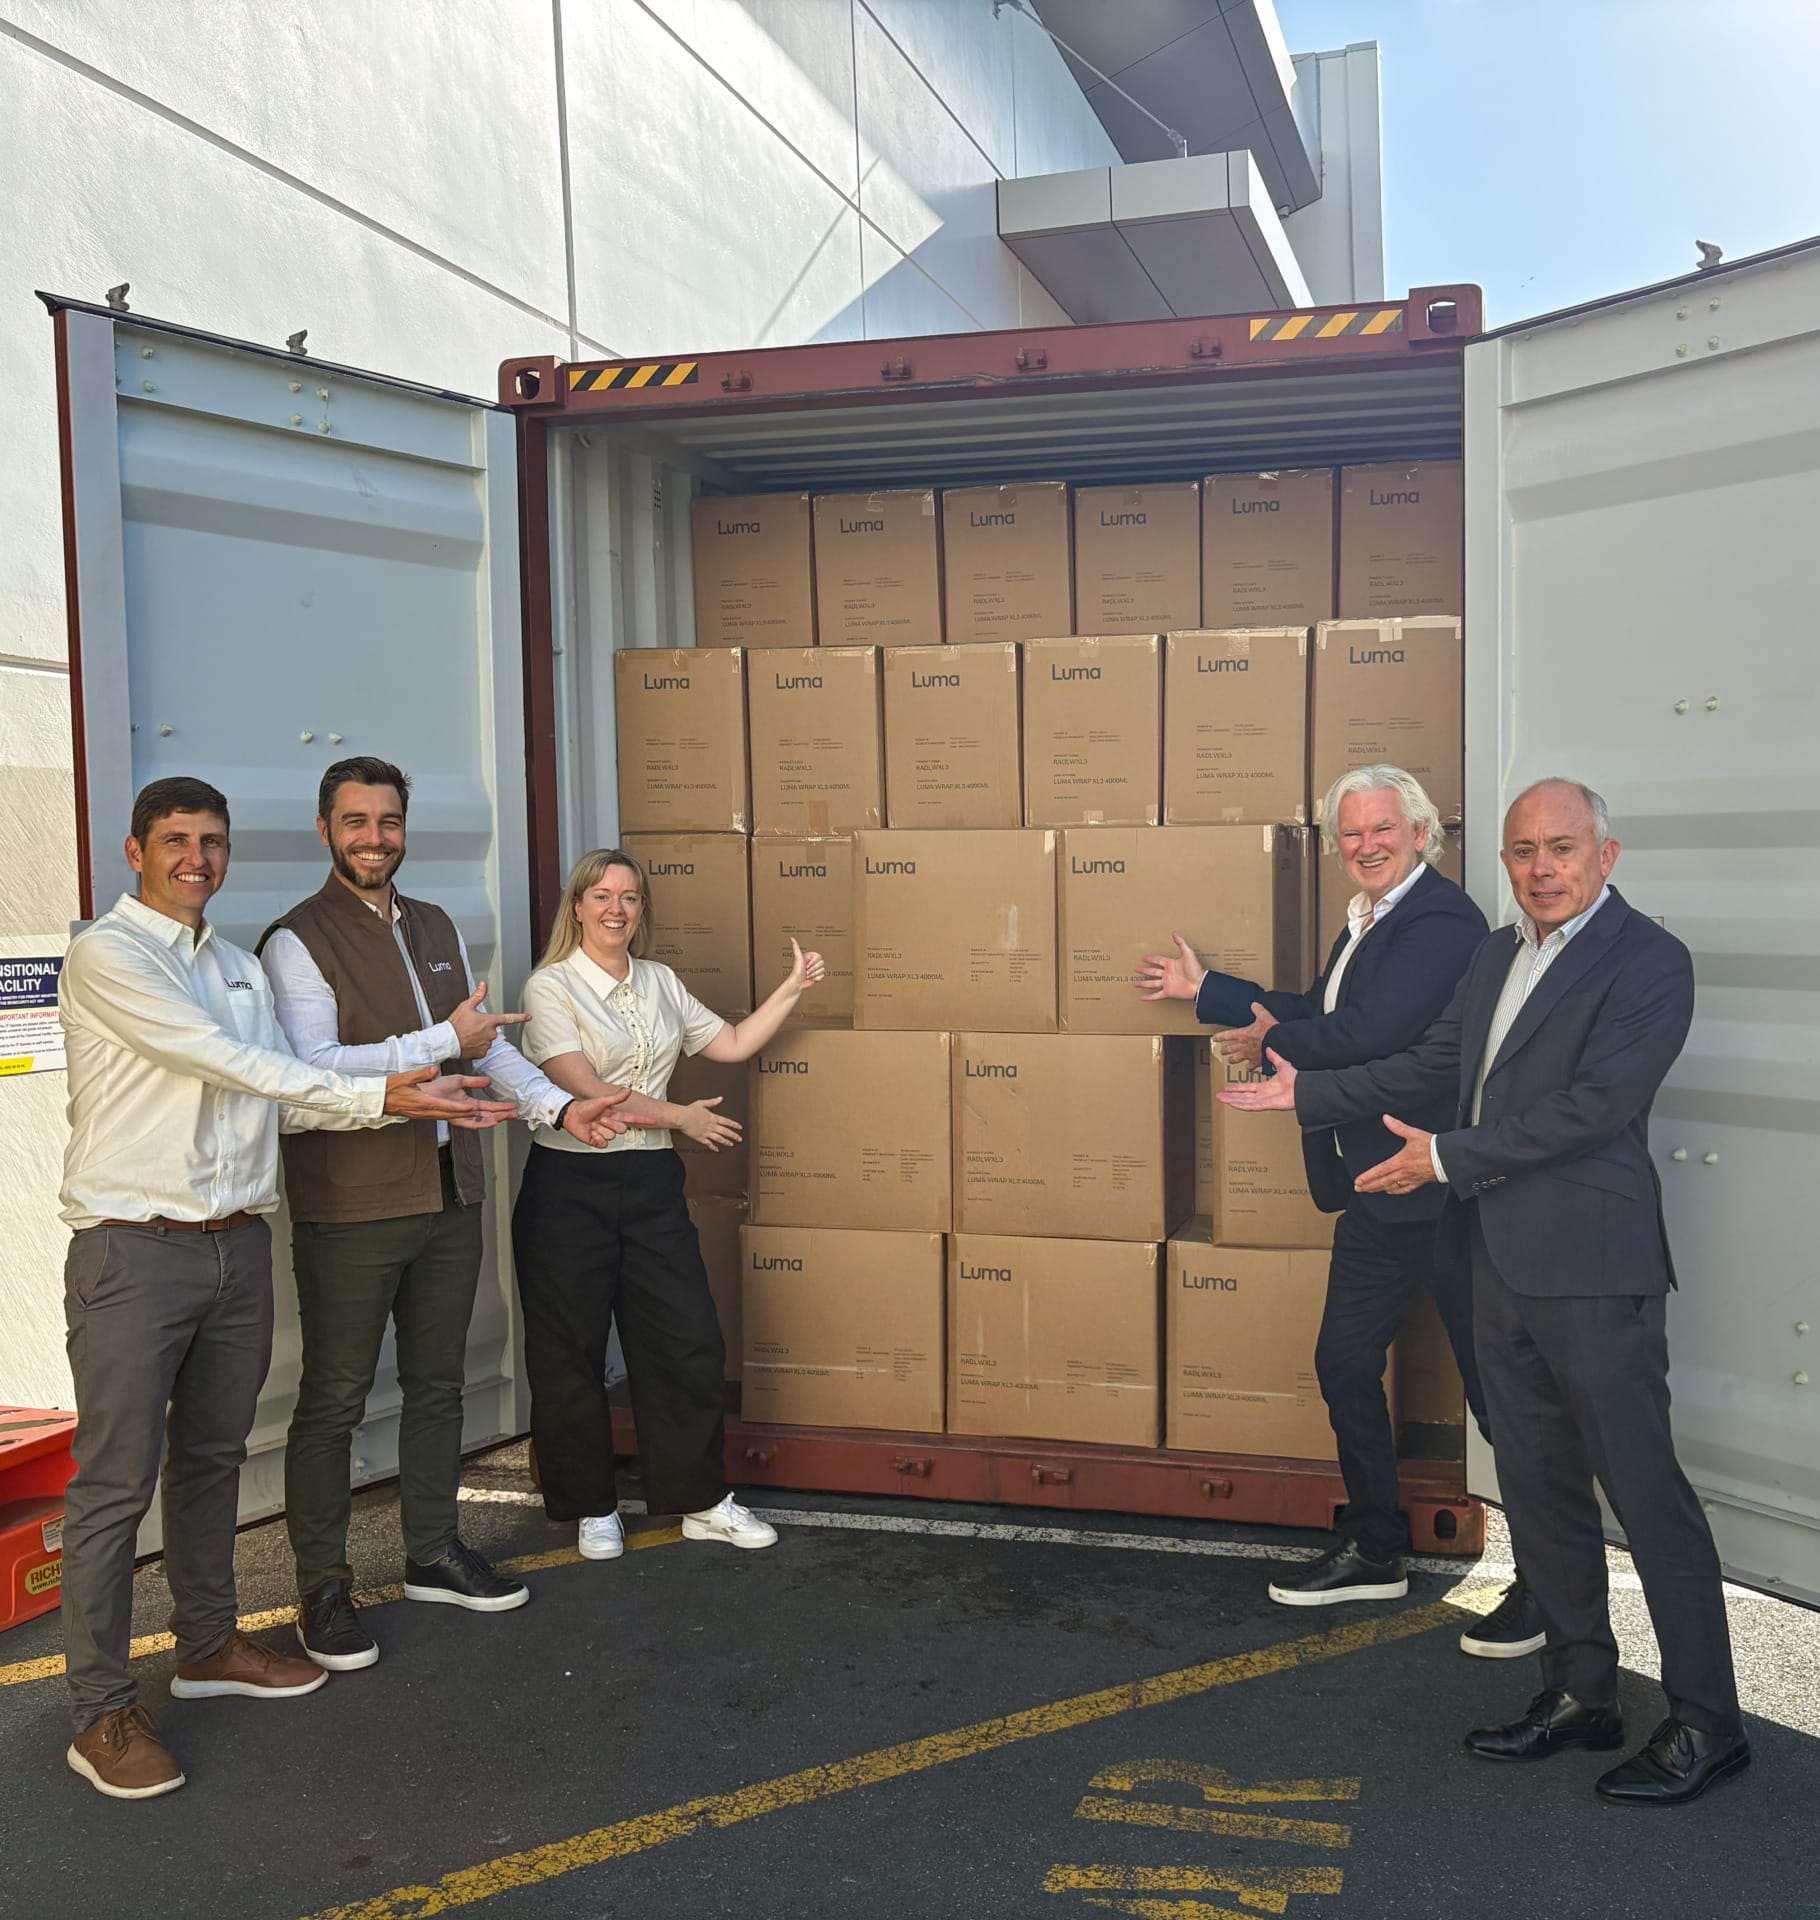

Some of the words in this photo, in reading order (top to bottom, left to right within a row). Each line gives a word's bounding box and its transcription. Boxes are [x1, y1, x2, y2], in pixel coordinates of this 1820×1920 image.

[1370, 489, 1420, 505] Luma
[1232, 498, 1280, 514] Luma
[840, 518, 884, 534] Luma
[970, 511, 1015, 527] Luma
[1101, 511, 1147, 527] Luma
[717, 520, 761, 535] Luma
[1350, 647, 1404, 664] Luma
[1197, 656, 1248, 672] Luma
[912, 672, 960, 688] Luma
[1052, 664, 1101, 681] Luma
[644, 673, 690, 689] Luma
[776, 673, 823, 689] Luma
[649, 860, 694, 876] Luma
[780, 861, 826, 877] Luma
[866, 857, 916, 875] Luma
[1072, 856, 1125, 874] Luma
[428, 962, 451, 972] Luma
[224, 978, 252, 990] Luma
[758, 1056, 809, 1074] Luma
[966, 1060, 1017, 1078] Luma
[1227, 1065, 1269, 1083] Lum
[753, 1252, 802, 1271] Luma
[960, 1261, 1011, 1282] Luma
[1183, 1270, 1237, 1291] Luma
[30, 1562, 63, 1585] RICH
